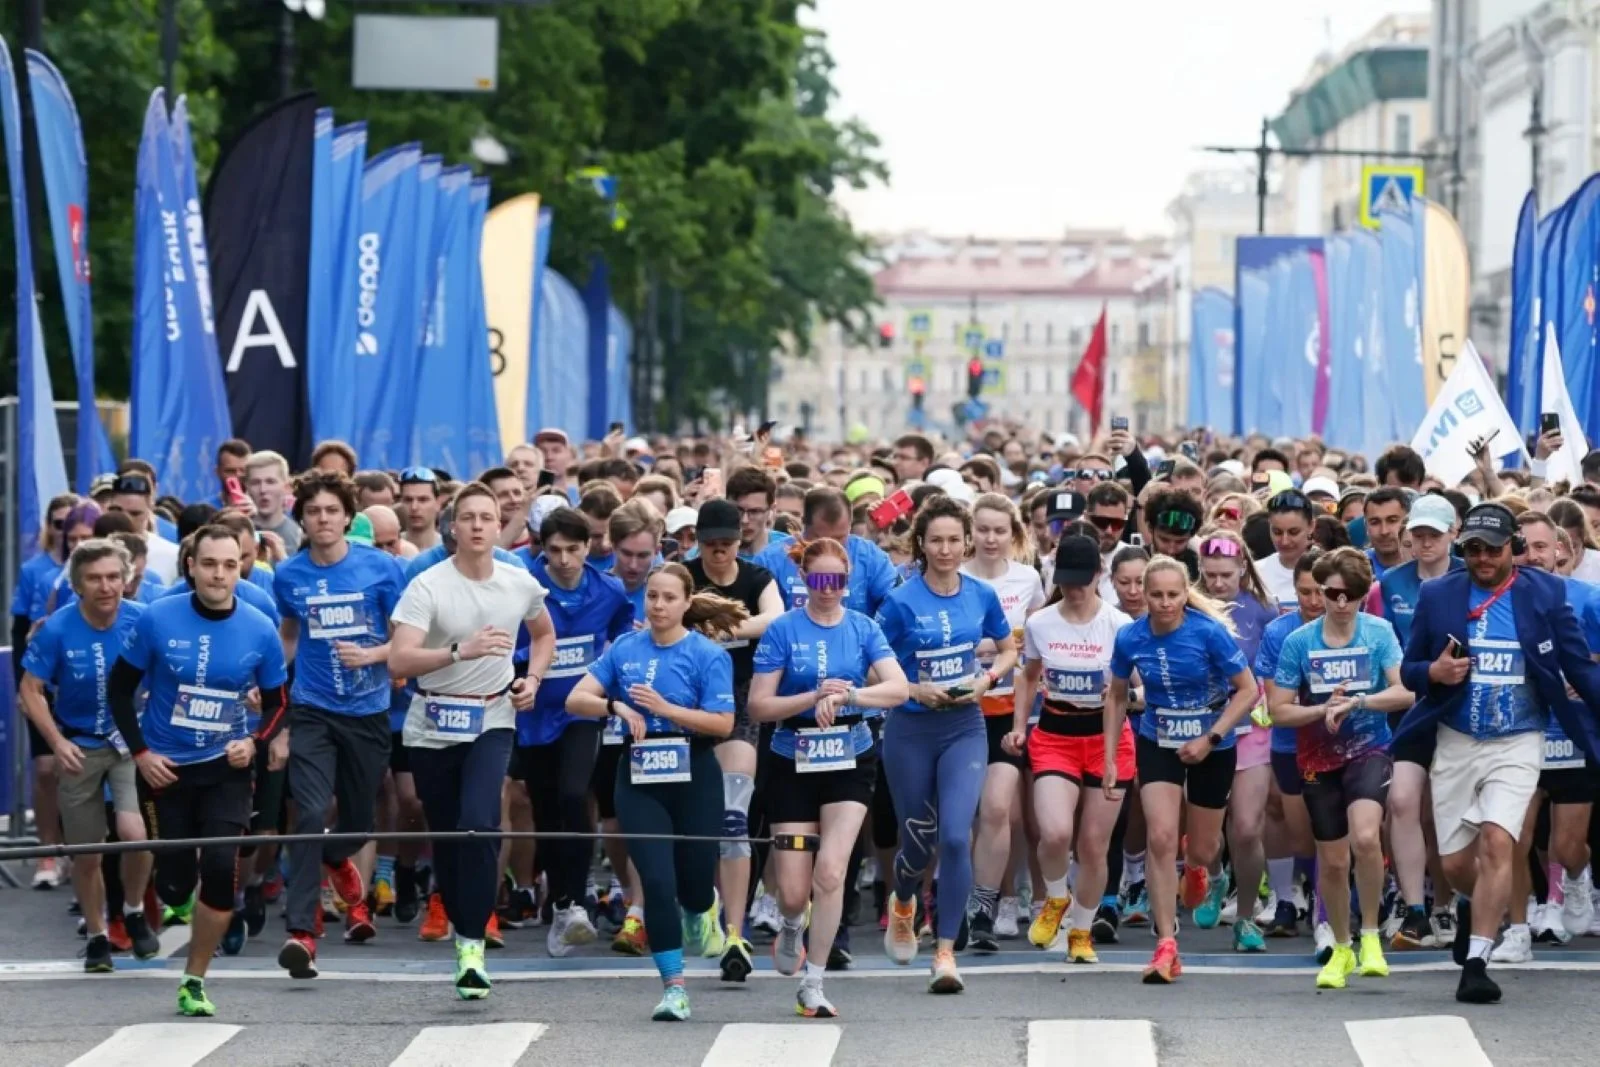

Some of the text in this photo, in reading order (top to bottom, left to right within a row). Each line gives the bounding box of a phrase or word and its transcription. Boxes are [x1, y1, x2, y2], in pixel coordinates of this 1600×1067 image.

[226, 289, 297, 372] A
[319, 606, 354, 626] 1090
[931, 657, 963, 678] 2192
[1323, 659, 1357, 679] 3501
[1478, 652, 1513, 672] 1247
[1058, 674, 1093, 691] 3004
[189, 699, 222, 719] 1091
[437, 708, 471, 729] 3125
[1167, 720, 1202, 737] 2406
[808, 738, 844, 758] 2492
[642, 750, 678, 770] 2359
